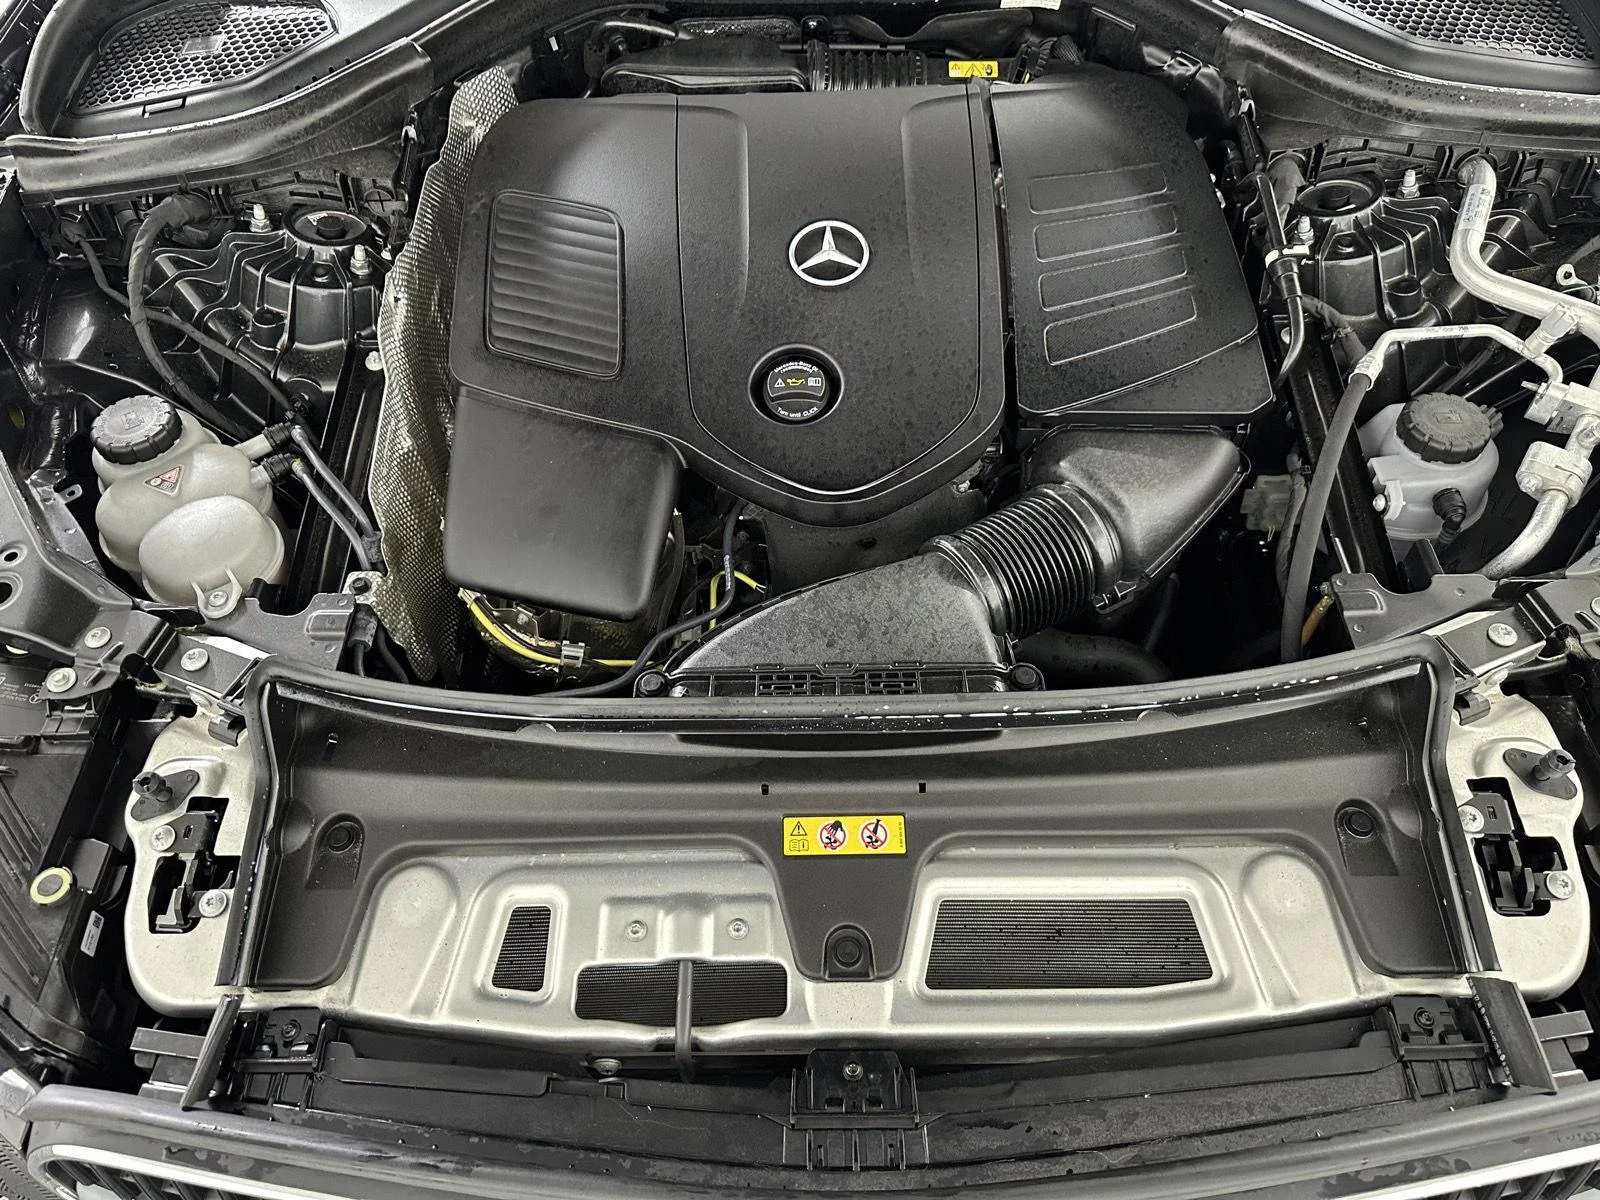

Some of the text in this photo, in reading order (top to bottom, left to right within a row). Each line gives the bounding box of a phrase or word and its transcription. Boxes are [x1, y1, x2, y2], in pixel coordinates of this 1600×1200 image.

[774, 361, 812, 373] Mercedes-Benz
[780, 366, 813, 374] recommended
[777, 406, 788, 416] Turn
[802, 406, 818, 416] CLICK
